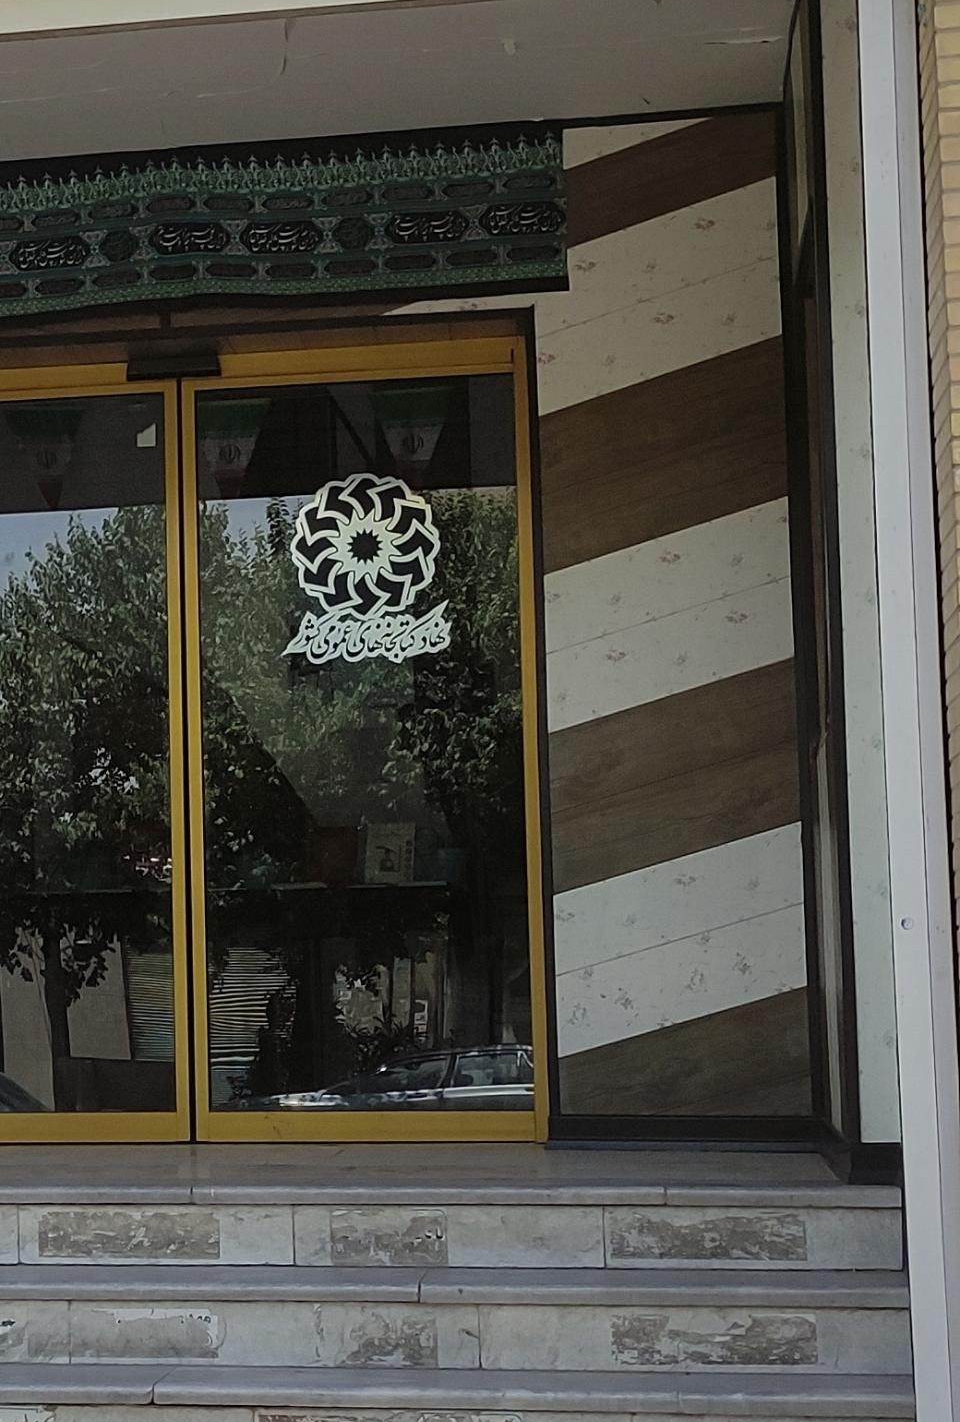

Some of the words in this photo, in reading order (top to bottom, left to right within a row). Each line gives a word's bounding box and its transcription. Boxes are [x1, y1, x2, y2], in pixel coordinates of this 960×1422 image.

[293, 612, 337, 650] کشور
[307, 623, 352, 660] عمومی
[418, 620, 447, 650] نهاد
